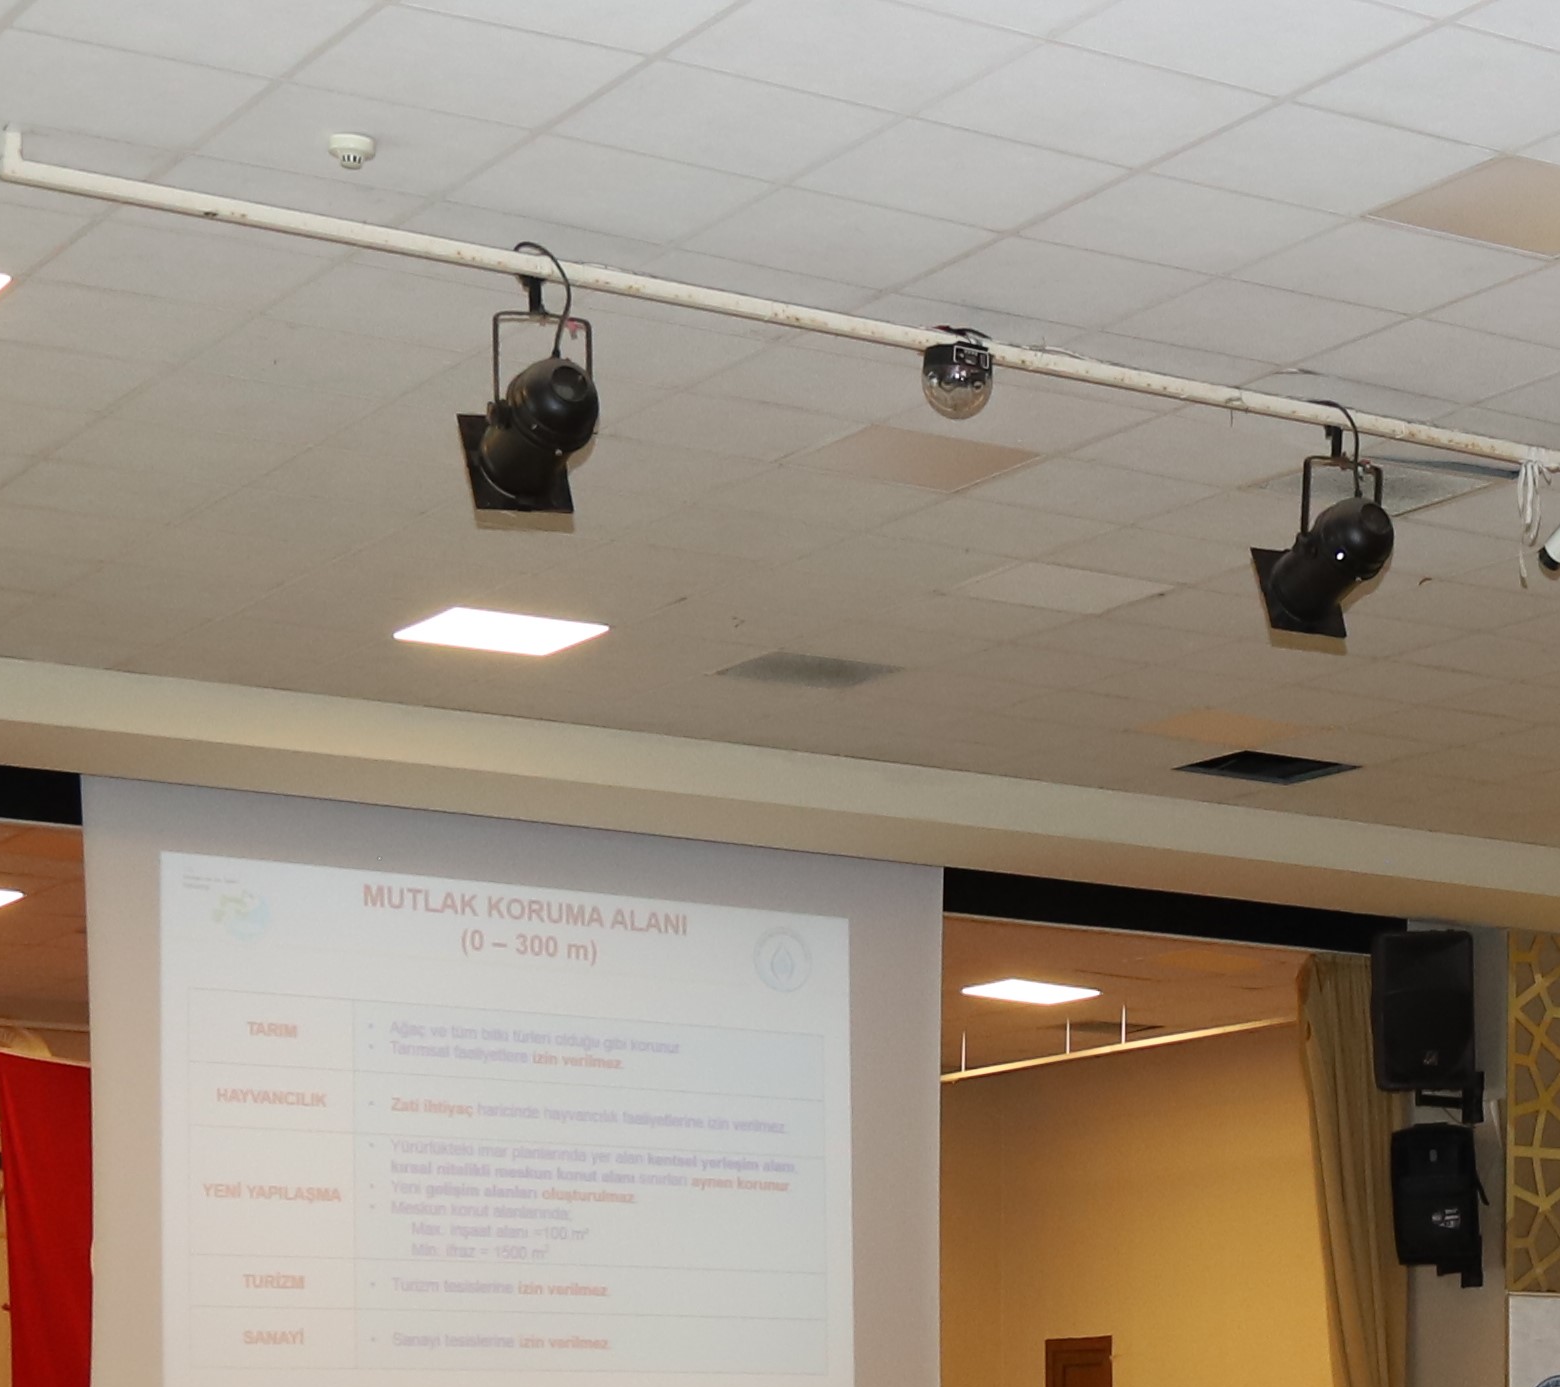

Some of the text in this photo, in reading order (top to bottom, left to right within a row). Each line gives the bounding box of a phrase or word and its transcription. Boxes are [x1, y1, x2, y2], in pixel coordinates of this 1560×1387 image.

[362, 883, 687, 936] MUTLAK KORUMA ALANI
[460, 929, 484, 955] (0
[515, 933, 558, 958] 300
[566, 939, 598, 967] m)
[246, 1020, 297, 1039] TARIM
[532, 1051, 557, 1066] izin
[216, 1087, 327, 1109] HAYVANCILIK
[424, 1099, 473, 1117] ihtiyaç
[202, 1181, 342, 1204] YENİ YAPILAŞMA
[242, 1271, 305, 1290] TURİZM
[517, 1280, 543, 1295] izin
[243, 1328, 305, 1346] SANAYİ
[519, 1334, 544, 1349] izin
